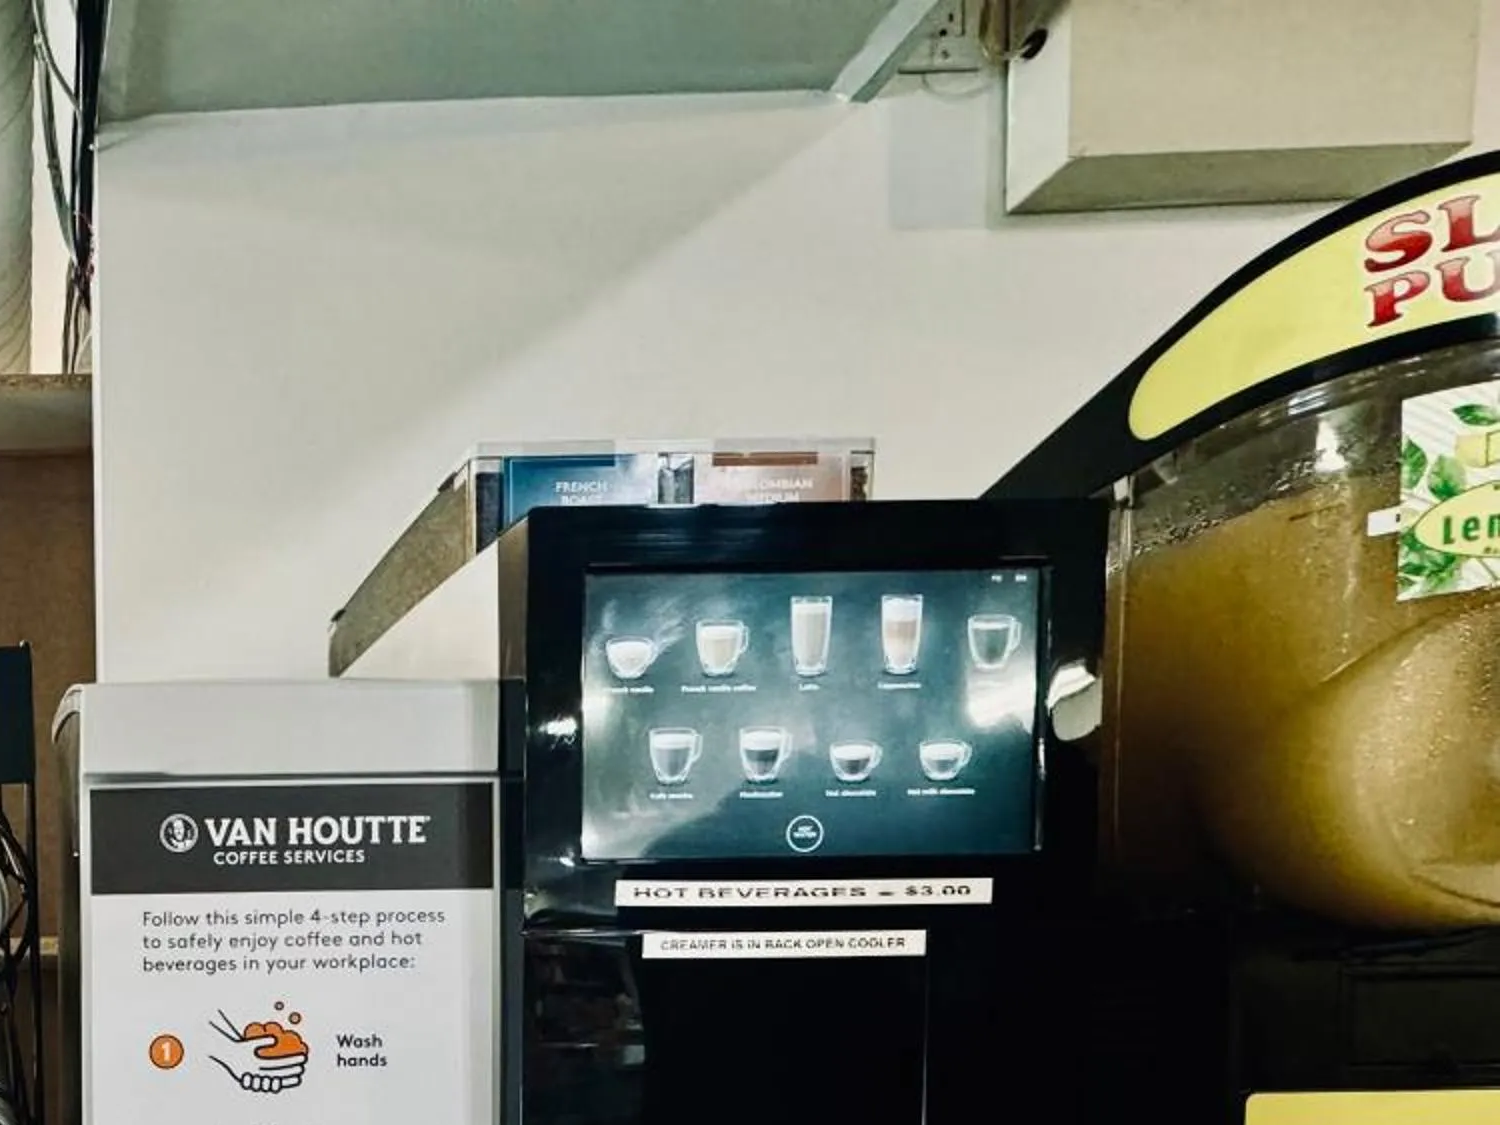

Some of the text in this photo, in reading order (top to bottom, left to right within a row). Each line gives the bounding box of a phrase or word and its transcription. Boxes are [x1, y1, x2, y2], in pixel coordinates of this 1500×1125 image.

[205, 815, 427, 846] VAN HOUTTE
[213, 850, 365, 865] COFFEE SERVICES
[634, 887, 688, 898] HOT
[698, 886, 866, 898] BEVERAGES
[905, 885, 971, 897] $3.00
[143, 909, 445, 929] Follow this simple 4-step process
[143, 931, 422, 952] to safely enjoy coffee and hot
[661, 940, 727, 951] CREAMER
[732, 940, 743, 950] IS
[805, 938, 845, 949] OPEN
[848, 937, 905, 949] COOLER
[143, 954, 415, 975] beverages in your workplace:
[337, 1034, 382, 1048] Wash
[337, 1053, 387, 1067] hands
